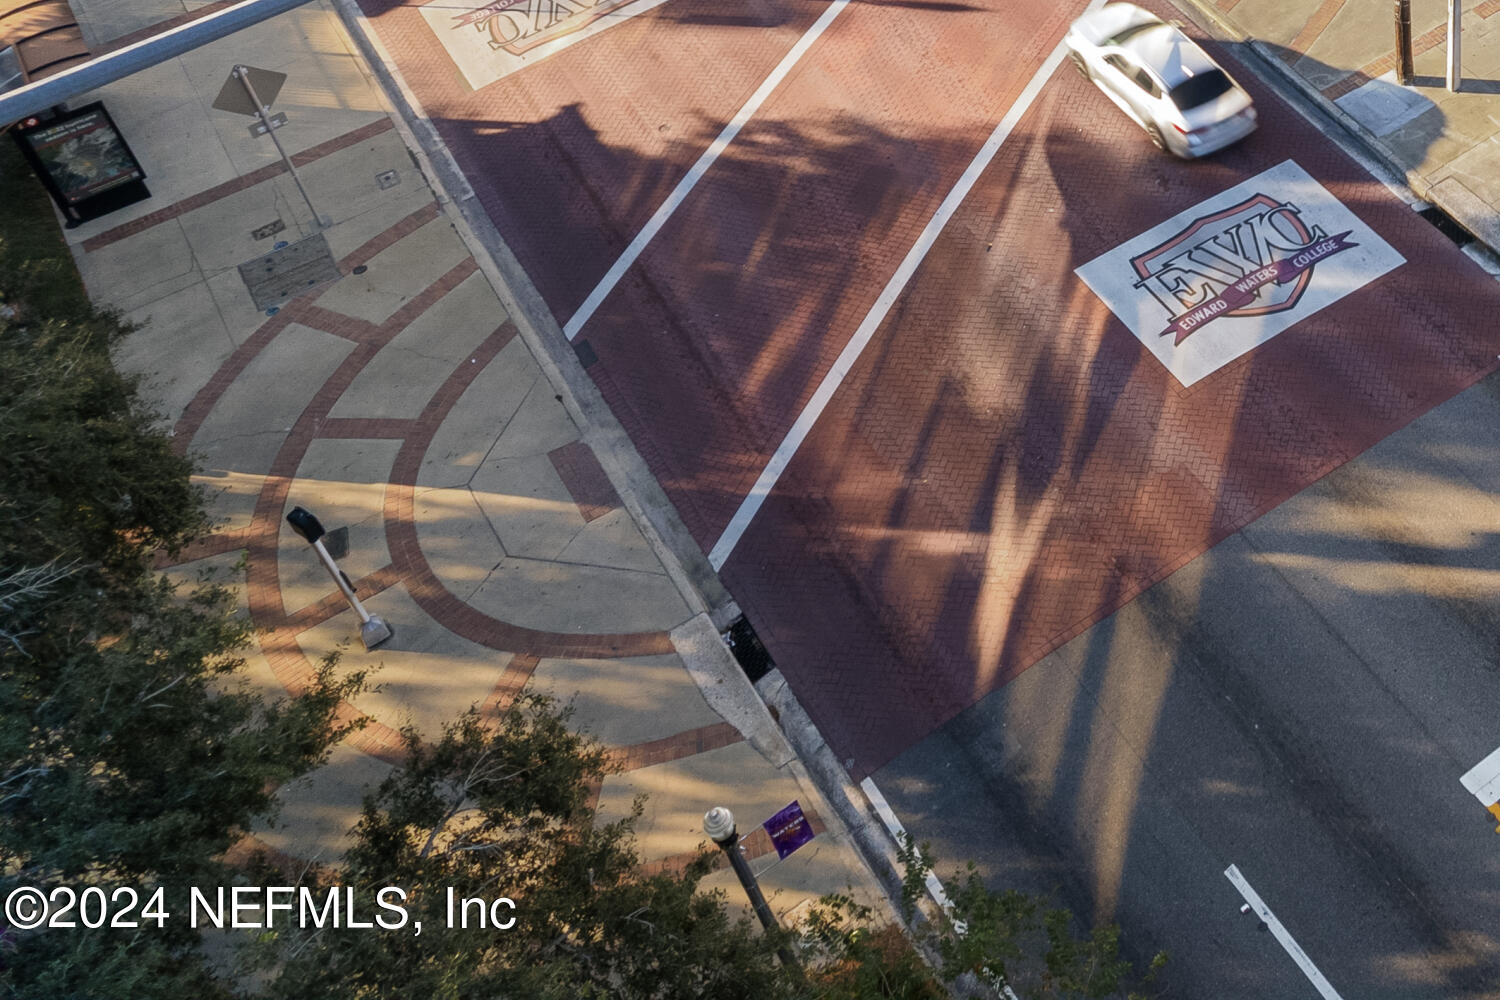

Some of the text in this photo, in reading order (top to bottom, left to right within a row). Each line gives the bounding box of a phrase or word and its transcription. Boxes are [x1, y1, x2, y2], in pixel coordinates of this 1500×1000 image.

[1178, 239, 1339, 331] EDWARD WATERS COLLEGE
